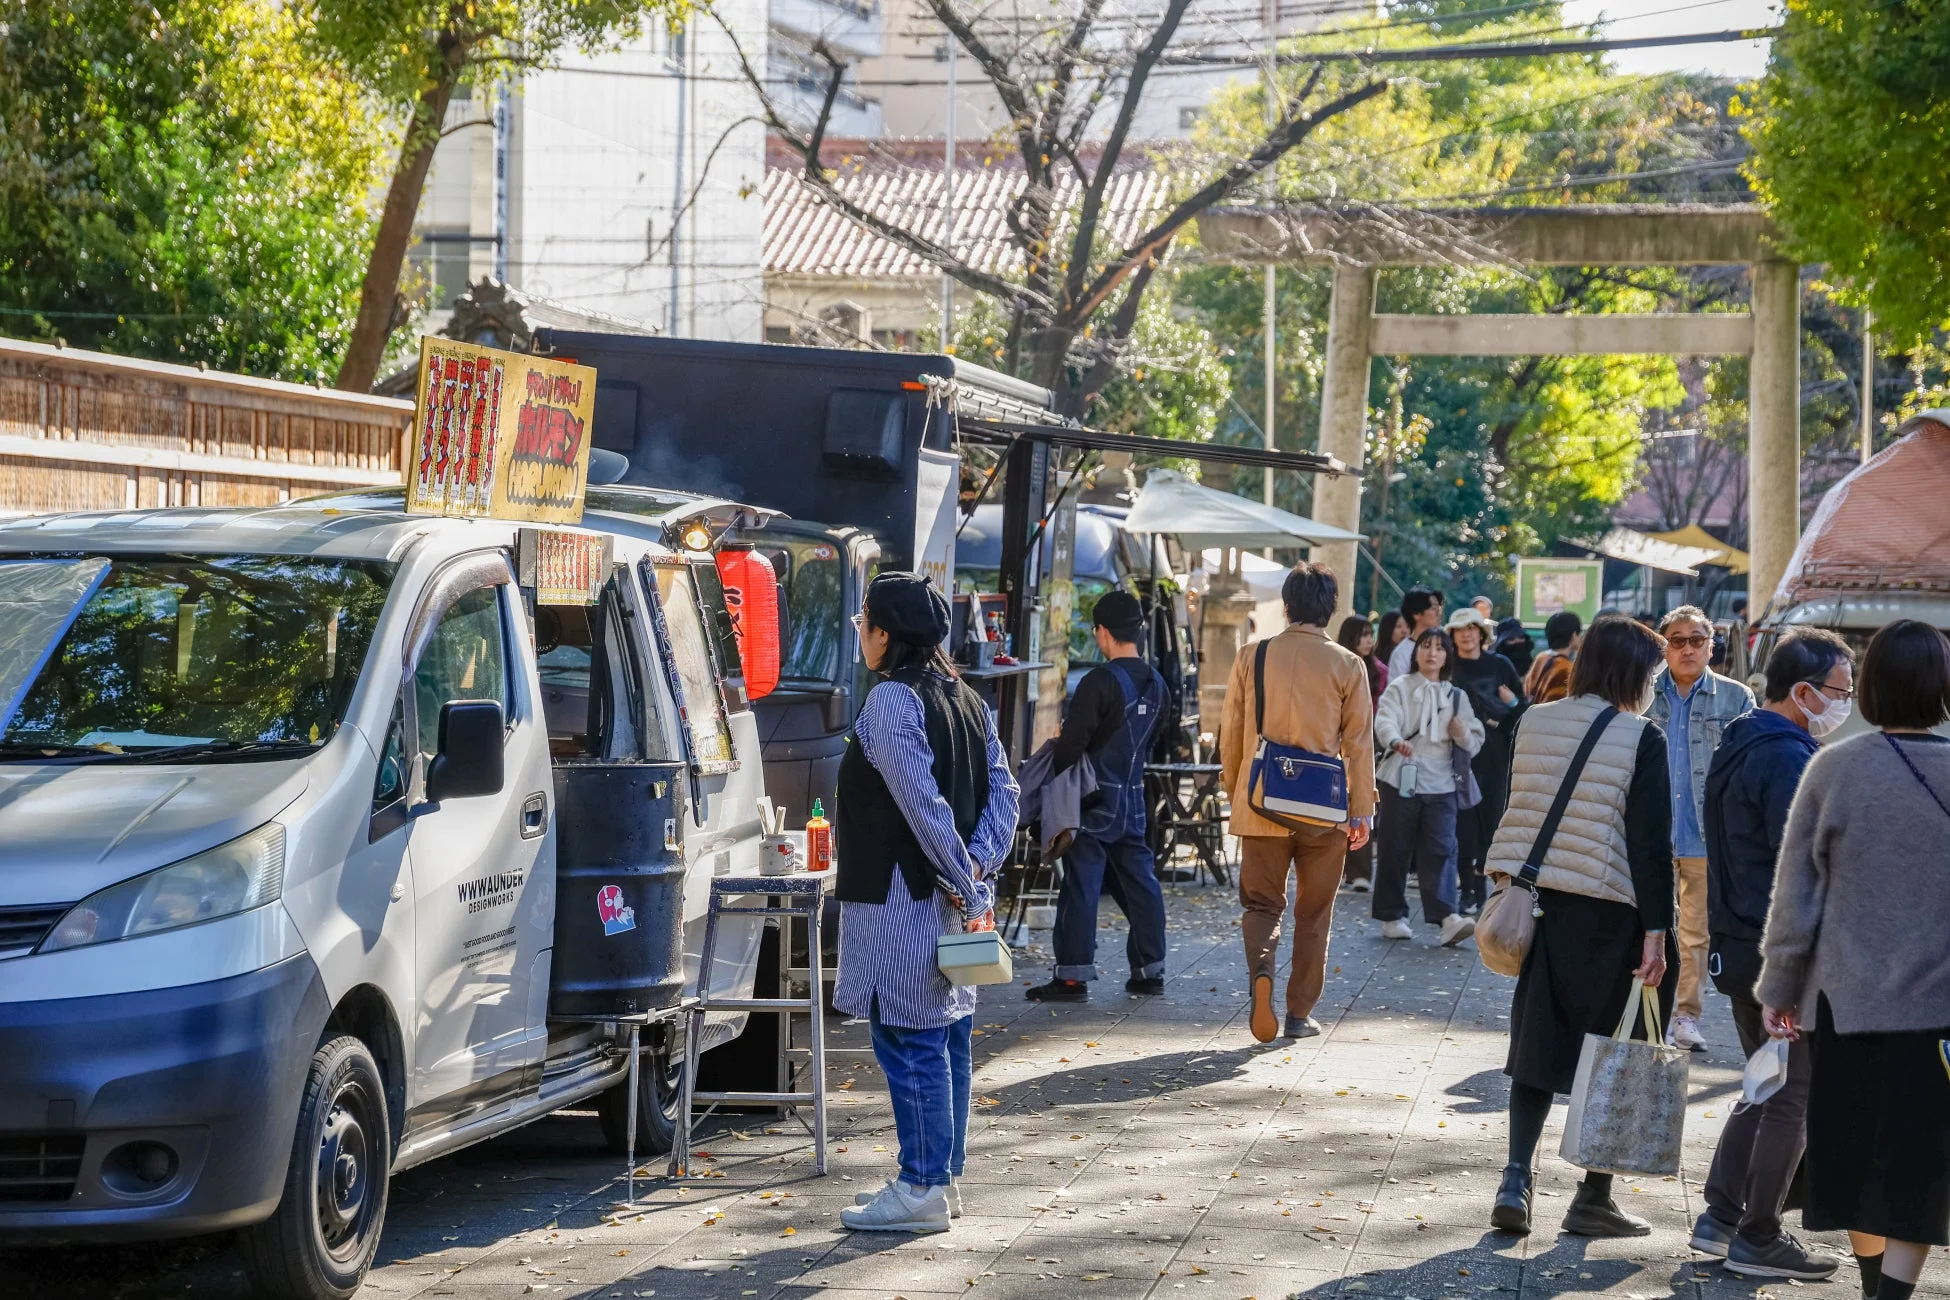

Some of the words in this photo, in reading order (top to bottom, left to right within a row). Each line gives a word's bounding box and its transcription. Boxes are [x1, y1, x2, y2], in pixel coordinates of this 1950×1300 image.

[514, 400, 584, 466] ホルモン
[458, 867, 524, 903] WWWAUNDER
[468, 891, 514, 914] DESIGNWORKS
